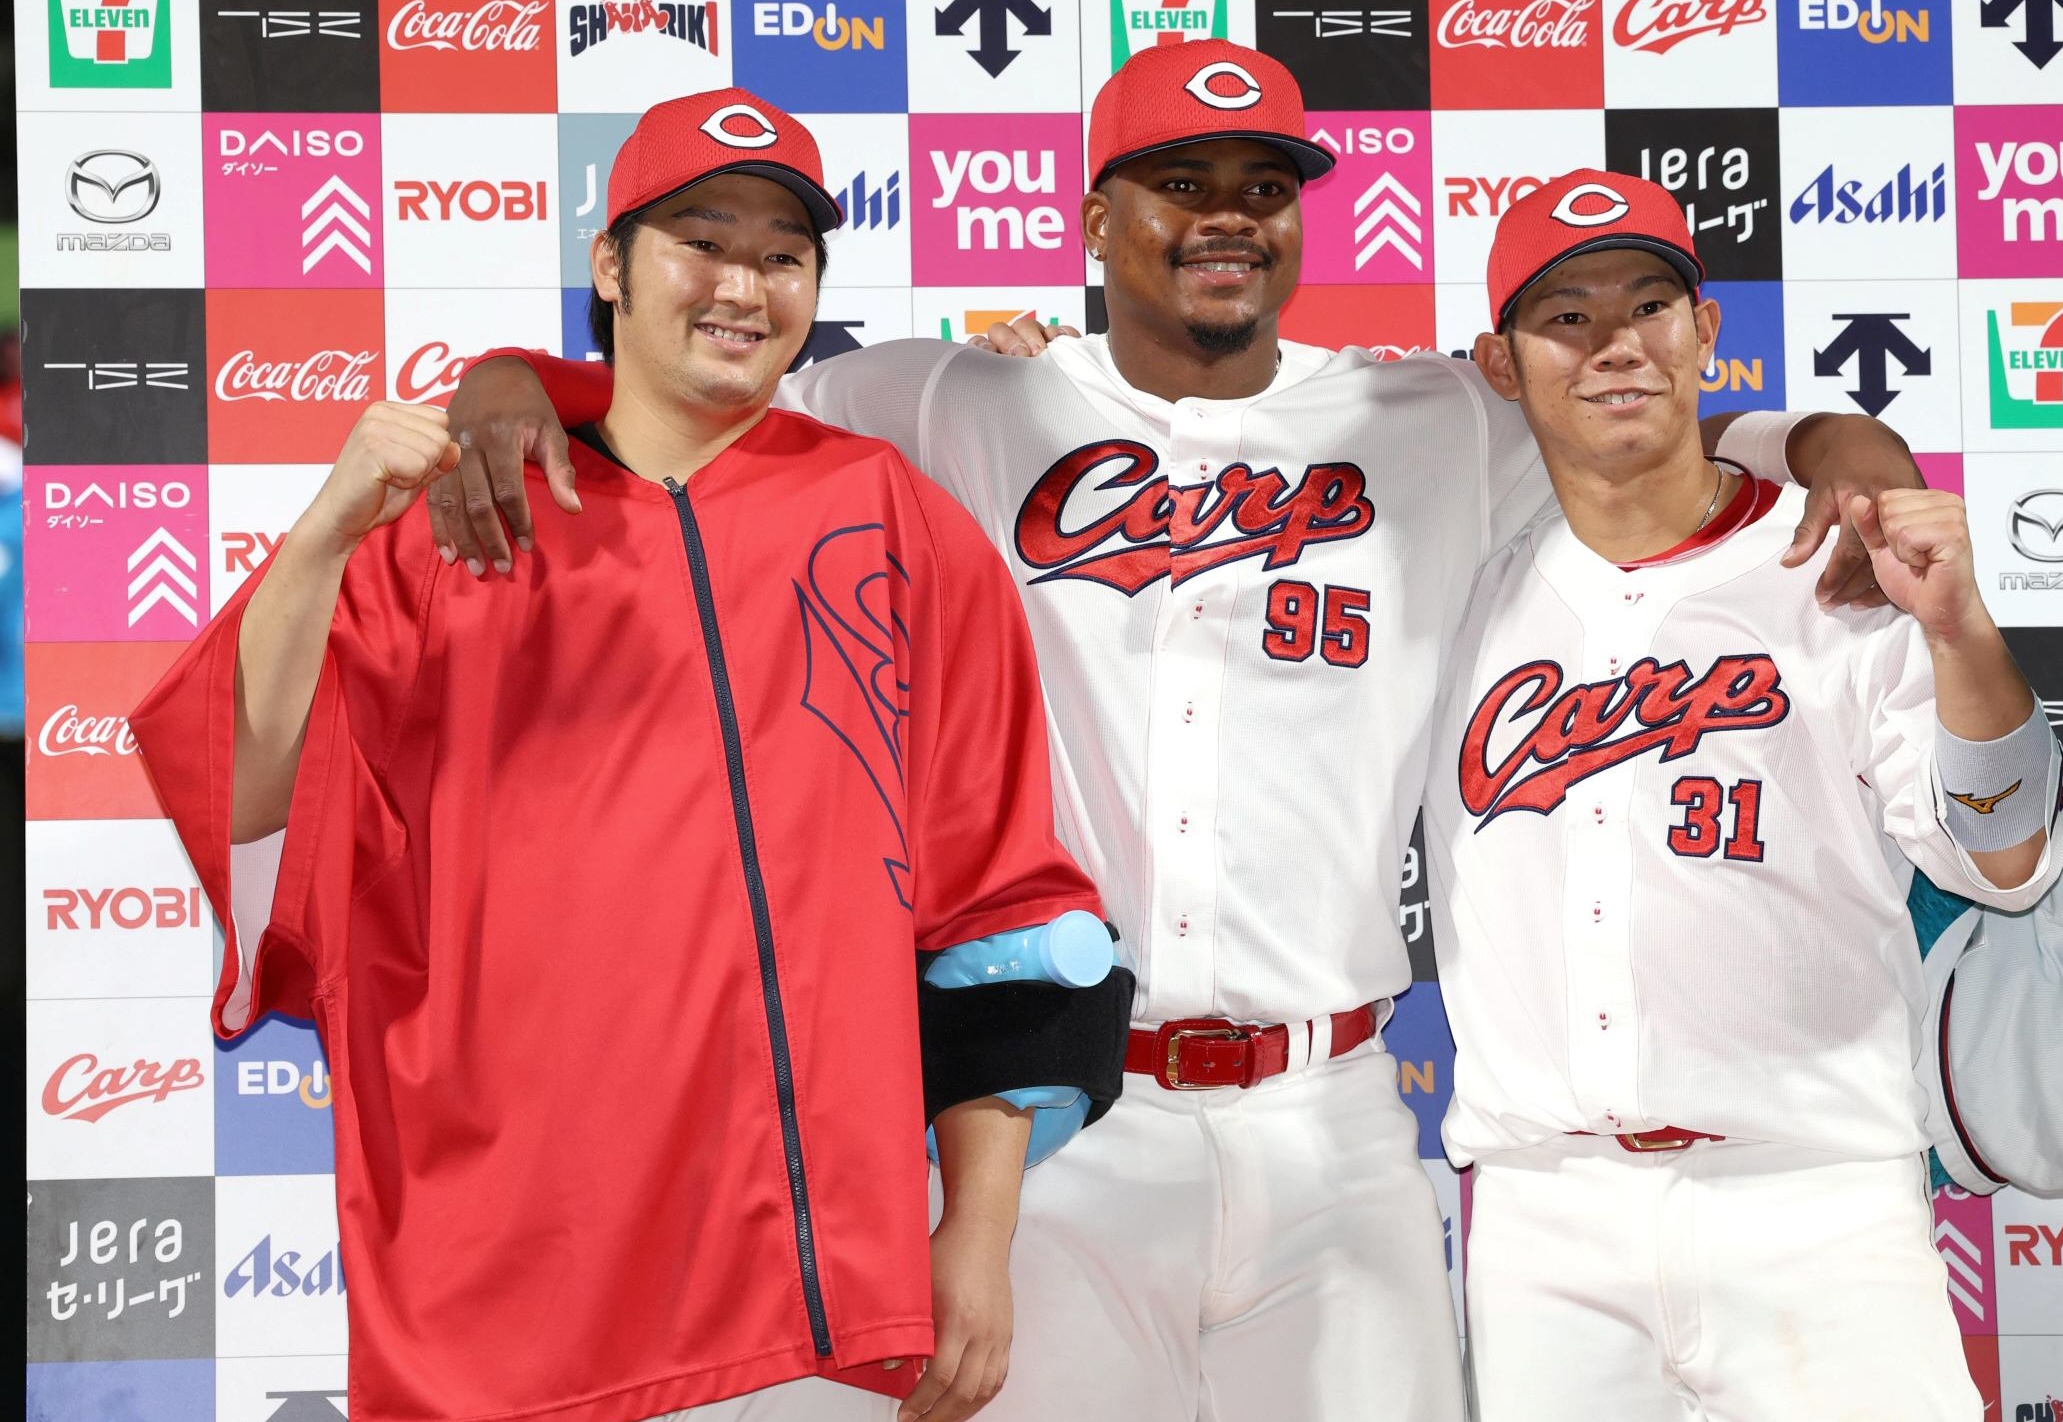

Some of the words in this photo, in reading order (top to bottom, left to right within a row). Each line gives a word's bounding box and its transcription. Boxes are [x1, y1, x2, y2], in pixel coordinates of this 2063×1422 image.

[387, 0, 549, 51] Coca-Cola
[1436, 0, 1594, 49] Coca-Cola
[1612, 0, 1767, 55] Carp
[219, 129, 364, 157] DAISO
[1310, 127, 1415, 155] AISO
[221, 161, 278, 177] ダイソー
[928, 149, 1056, 209] you
[1789, 162, 1946, 225] Asahi
[1974, 141, 2063, 200] yo
[394, 180, 547, 222] RYOBI
[1444, 176, 1560, 217] RYO
[2002, 197, 2063, 242] m
[956, 206, 1065, 250] me
[214, 350, 380, 402] Coca-Cola
[2009, 350, 2063, 369] ELEV
[45, 482, 191, 509] DAISO
[1013, 438, 1375, 598] Carp
[46, 514, 104, 529] ダイソー
[1999, 572, 2063, 590] maz
[1262, 578, 1371, 669] 95
[1458, 653, 1791, 835] Carp
[1667, 776, 1765, 863] 31
[43, 887, 200, 930] RYOBI
[41, 1053, 205, 1124] Carp
[238, 1060, 334, 1109] EDIO
[224, 1233, 347, 1298] Asa
